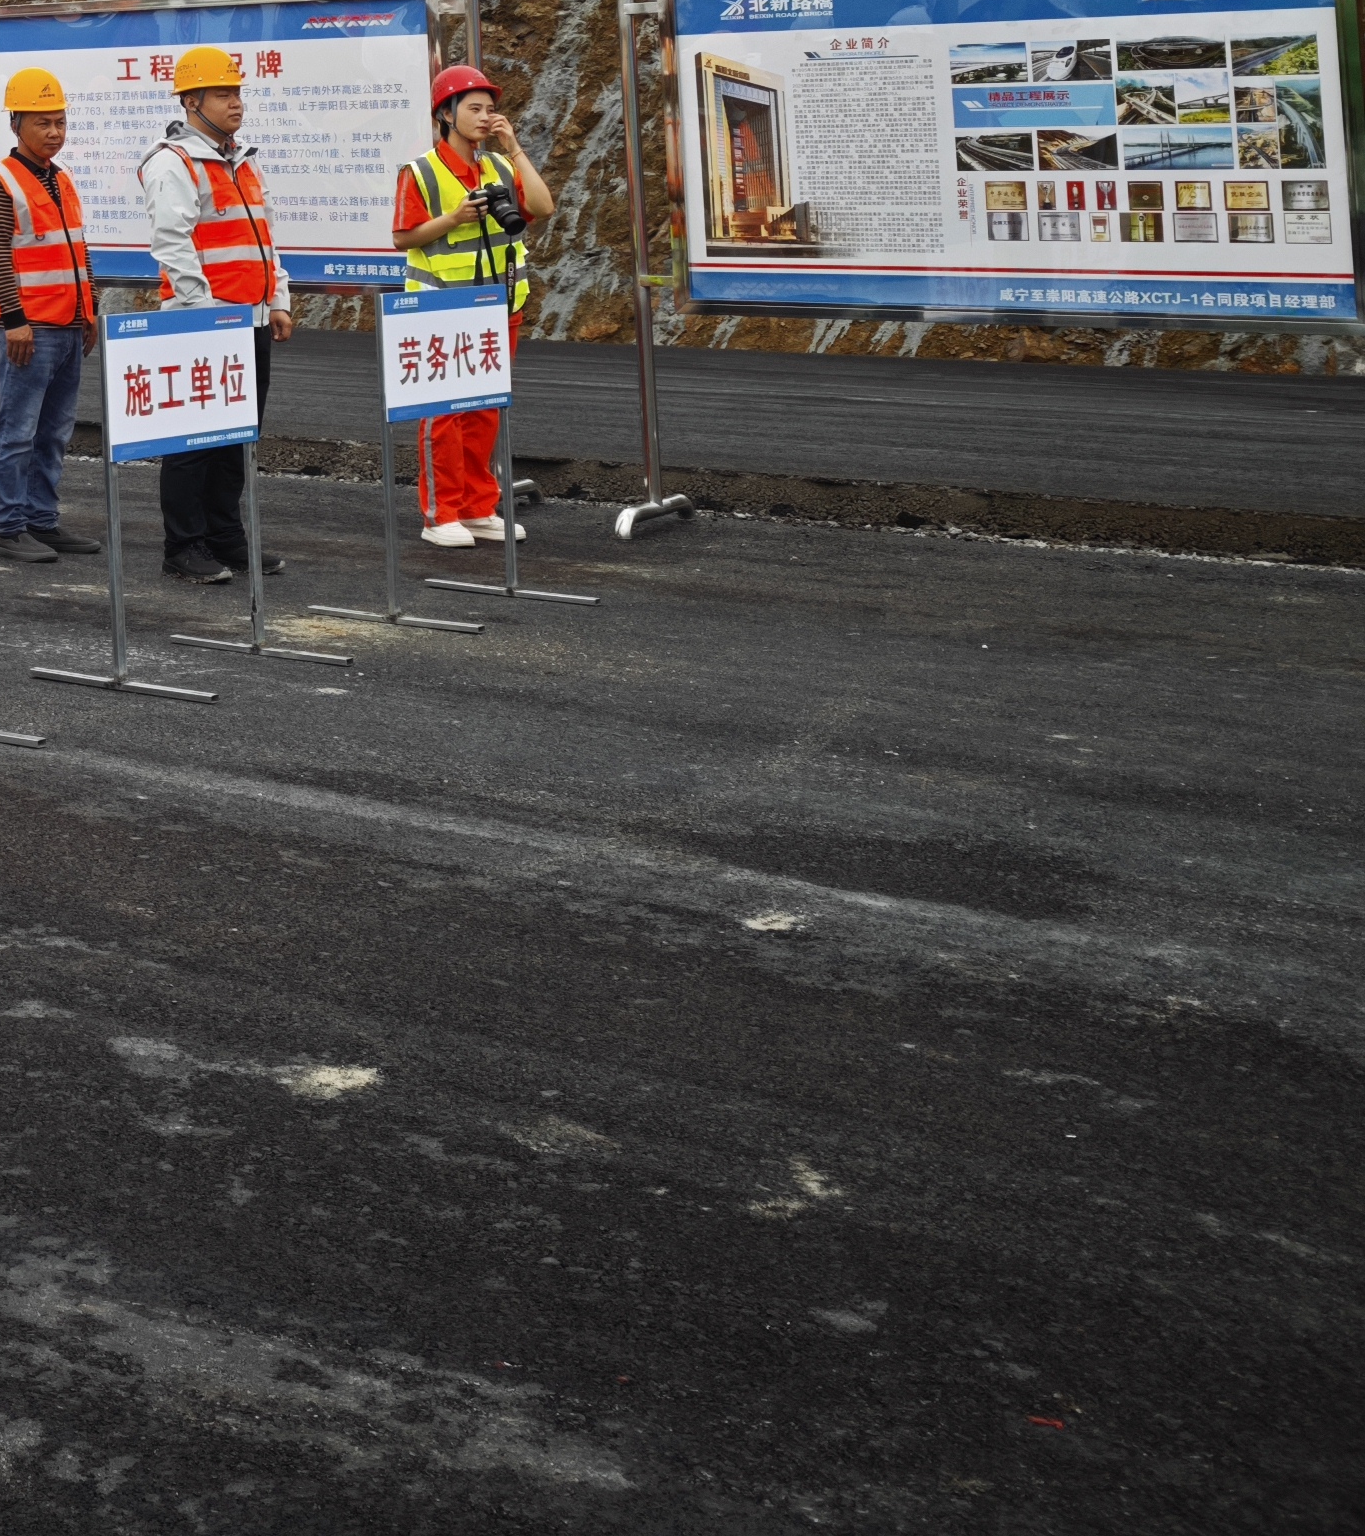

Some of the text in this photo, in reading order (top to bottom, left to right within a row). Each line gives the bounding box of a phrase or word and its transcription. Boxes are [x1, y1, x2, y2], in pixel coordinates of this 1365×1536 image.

[749, 10, 833, 20] BEIXIN ROAD&BRIDGE
[829, 36, 890, 51] 企业简介
[988, 90, 1070, 102] 精品工程展示
[956, 177, 969, 220] 企业荣誉
[999, 288, 1336, 310] 咸宁至崇阳高速公路XCTJ-1合同段项目经理部
[398, 328, 502, 385] 劳务代表
[124, 353, 247, 417] 施工单位
